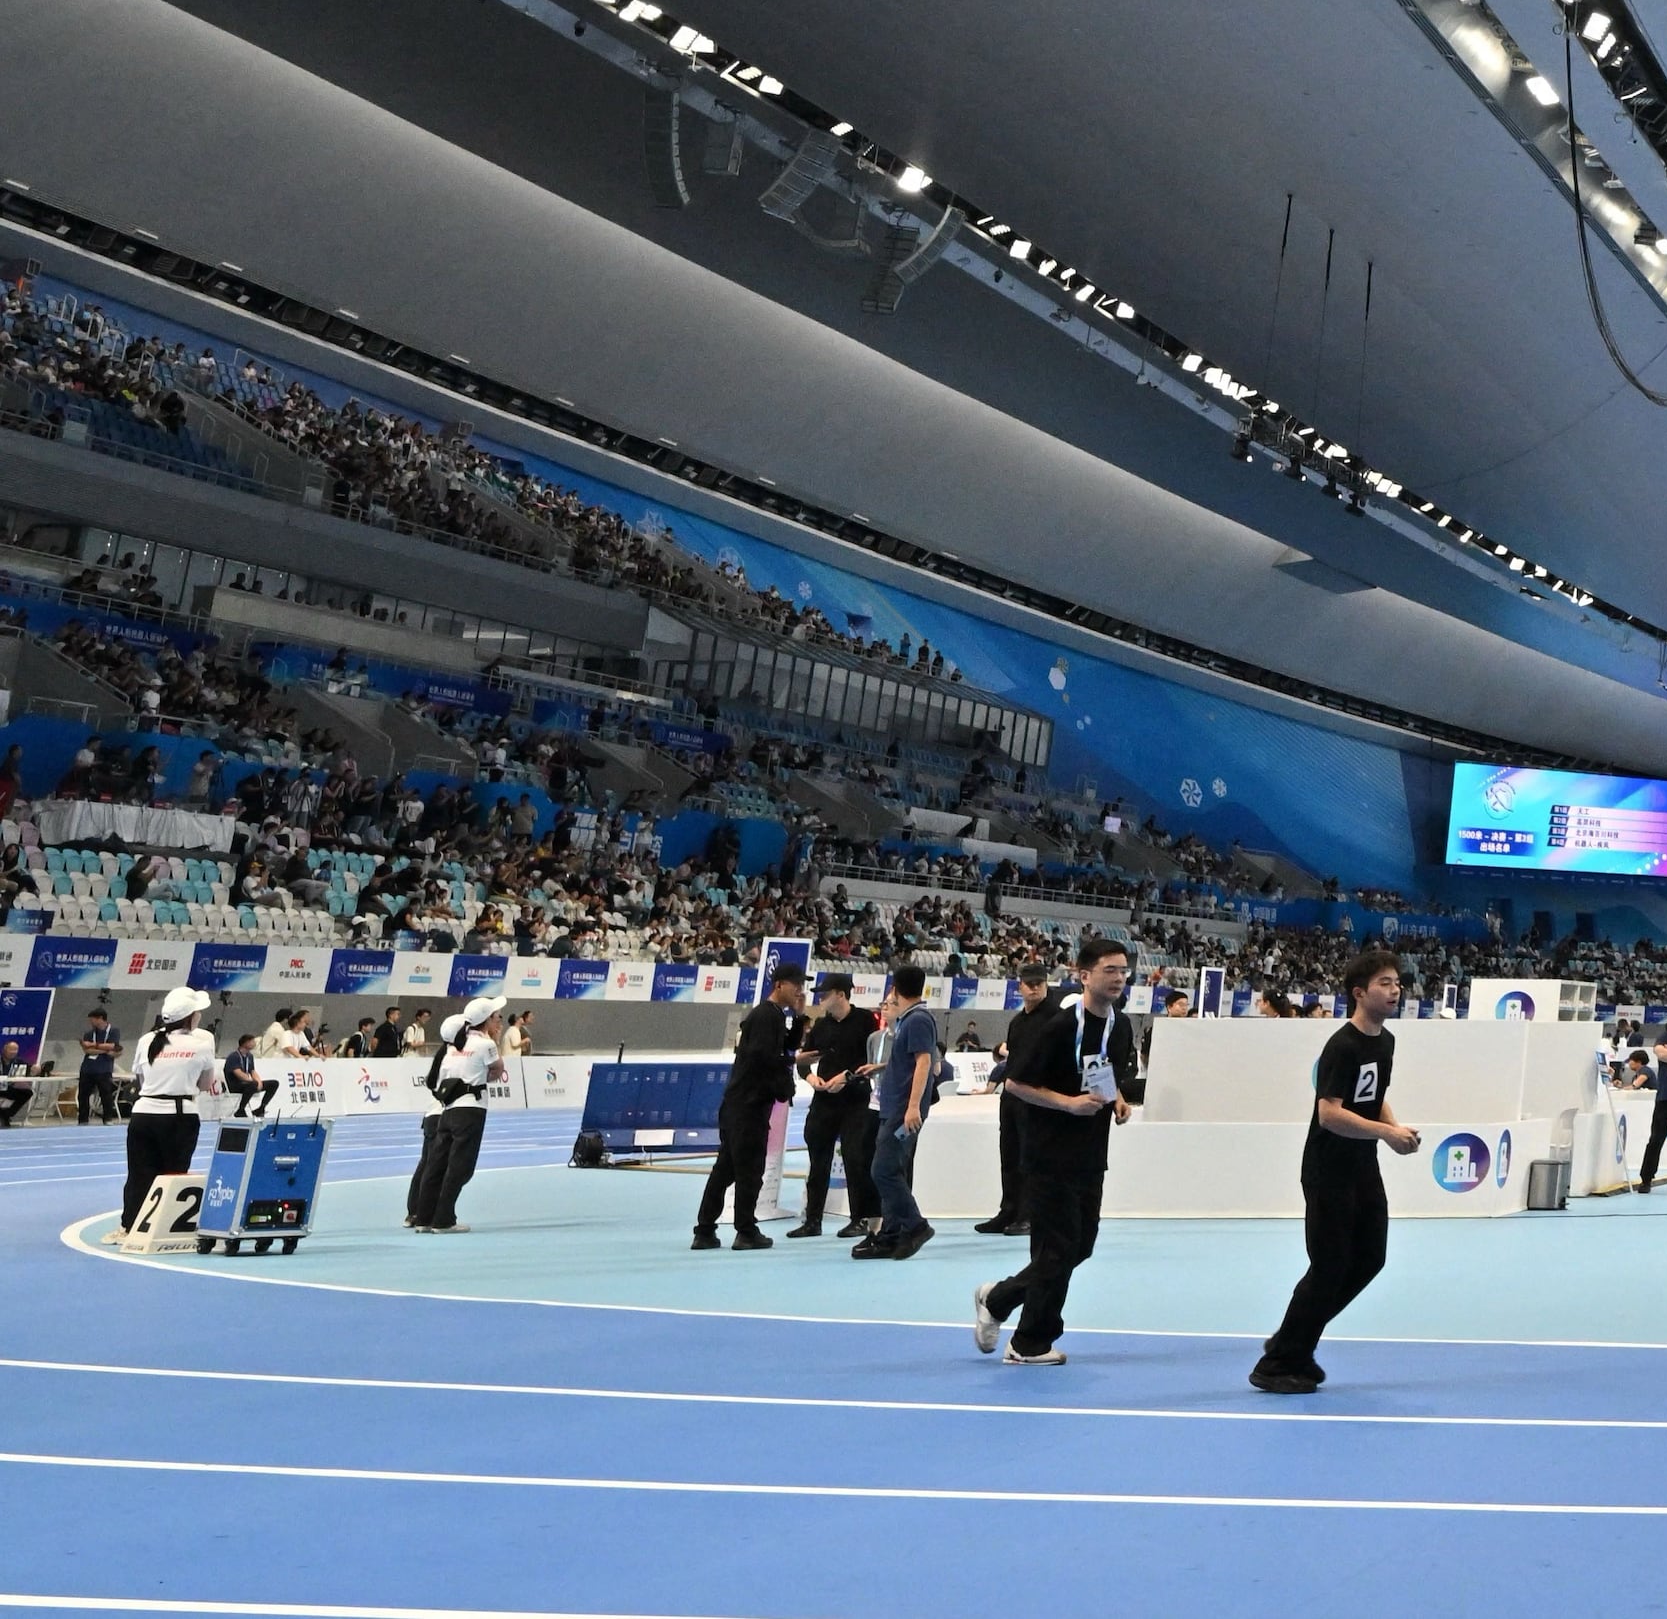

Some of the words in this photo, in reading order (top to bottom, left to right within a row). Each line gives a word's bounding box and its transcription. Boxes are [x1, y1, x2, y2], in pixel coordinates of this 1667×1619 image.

[146, 959, 177, 971] 北京国资
[159, 1050, 196, 1059] lunteer
[1358, 1070, 1375, 1098] 2
[291, 1091, 326, 1104] 北奥集团
[137, 1187, 163, 1233] 2
[169, 1187, 204, 1233] 2
